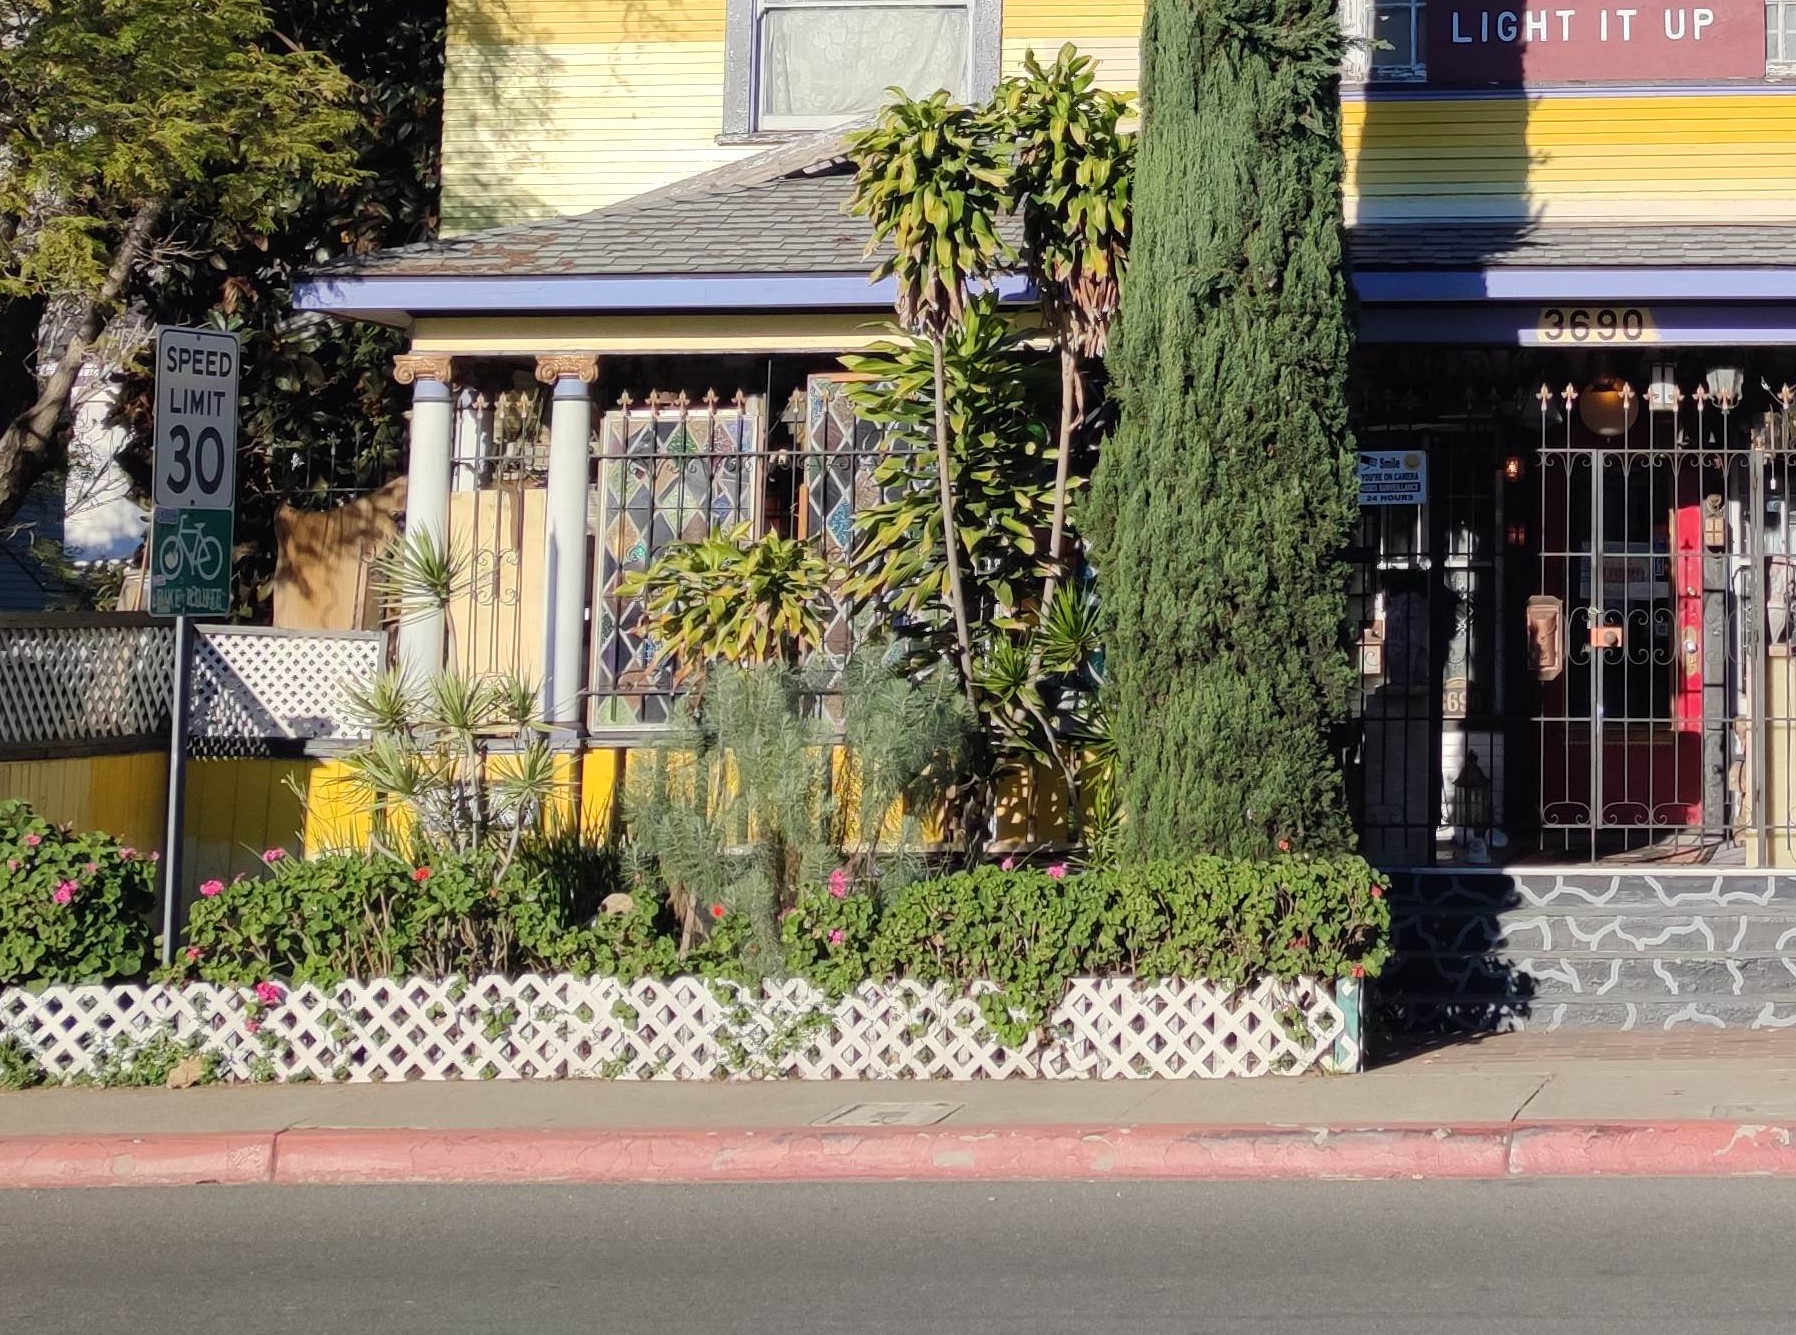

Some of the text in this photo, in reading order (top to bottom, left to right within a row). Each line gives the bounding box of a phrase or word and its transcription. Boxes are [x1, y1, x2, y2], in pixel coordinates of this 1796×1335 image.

[1452, 9, 1715, 43] LIGHT IT UP
[1544, 309, 1643, 341] 3690
[167, 346, 232, 377] SPEED
[170, 388, 226, 417] LIMIT
[166, 424, 225, 495] 30
[1380, 457, 1401, 470] Smile
[1380, 494, 1414, 502] HOURS
